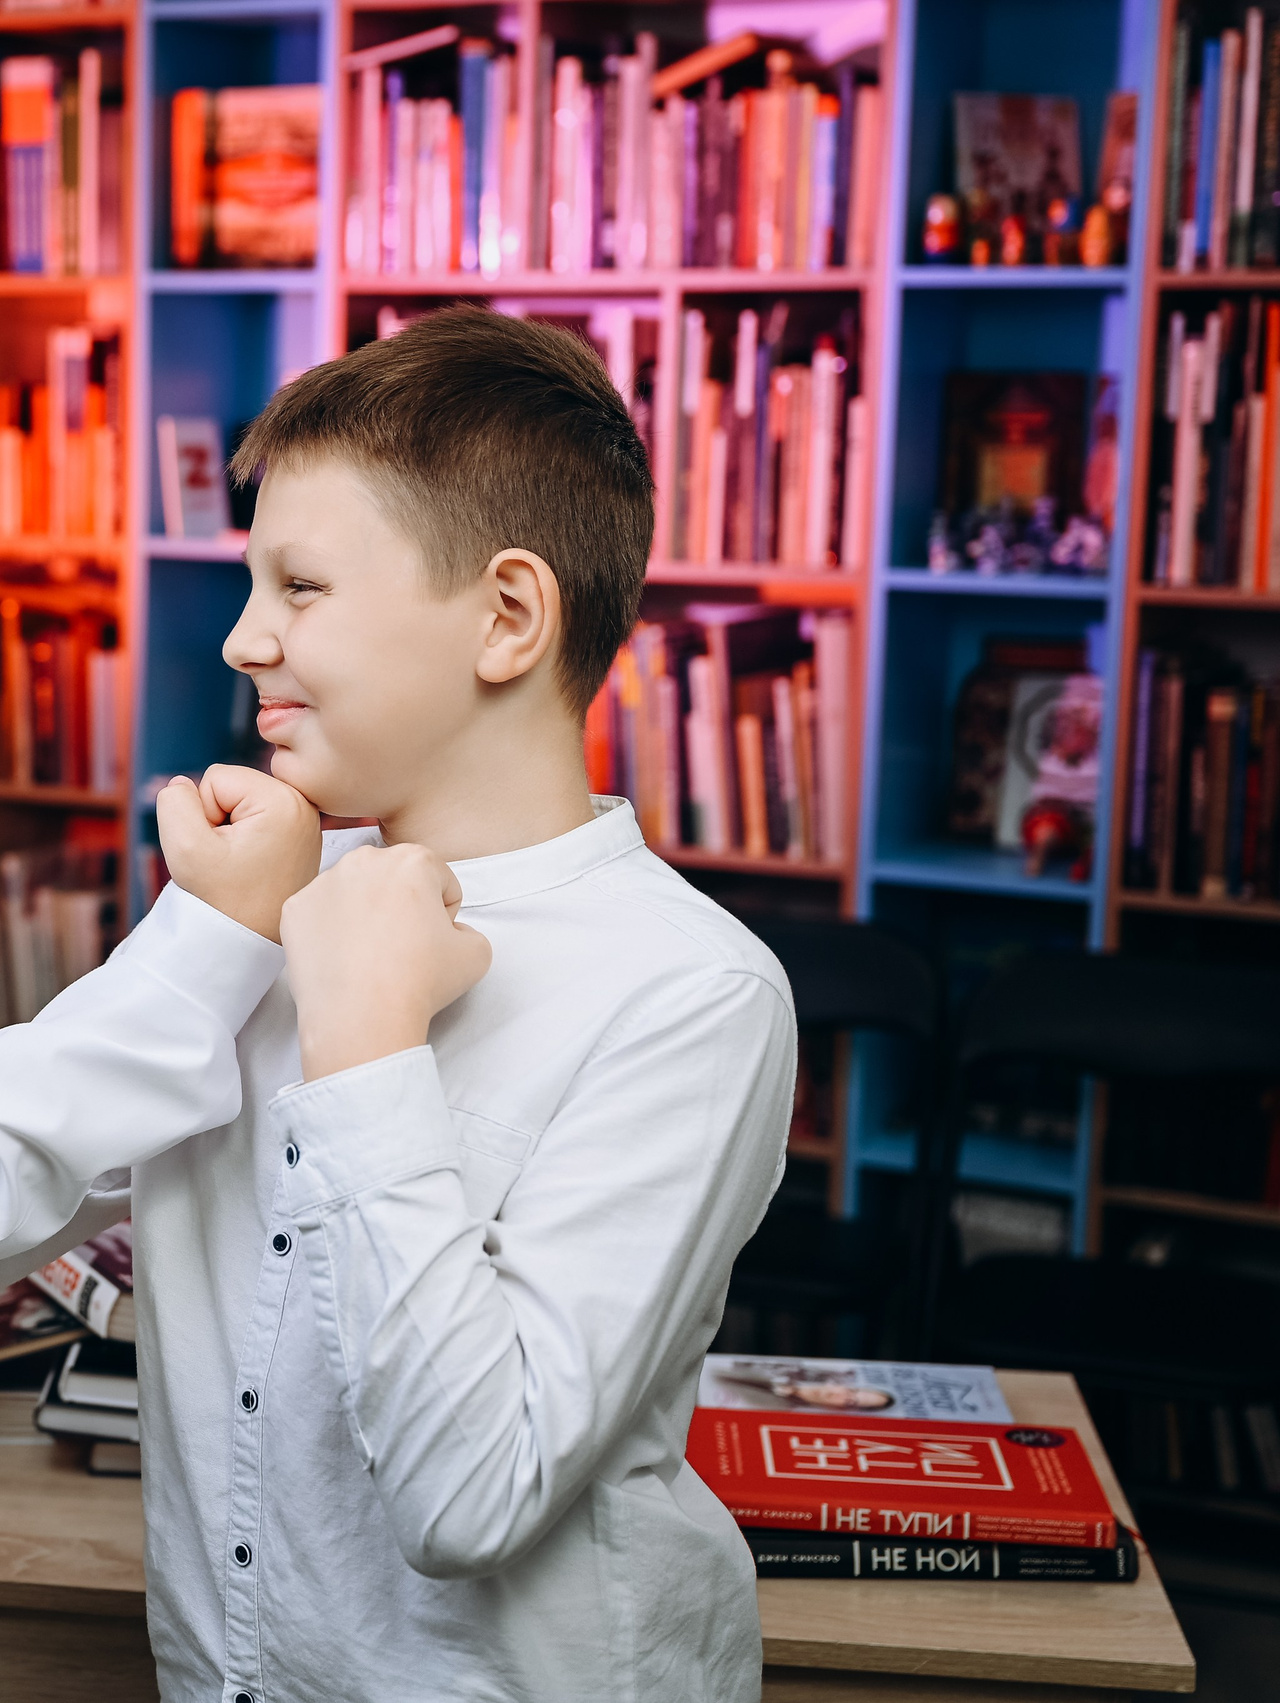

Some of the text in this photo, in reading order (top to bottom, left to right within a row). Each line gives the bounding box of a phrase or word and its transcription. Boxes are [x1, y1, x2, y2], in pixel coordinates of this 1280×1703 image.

[790, 1436, 853, 1471] НЕ
[854, 1439, 917, 1472] ТУ
[918, 1442, 984, 1479] ПИ
[835, 1507, 871, 1531] НЕ
[878, 1509, 953, 1536] ТУПИ
[871, 1547, 907, 1571] НЕ
[916, 1545, 980, 1573] НОЙ
